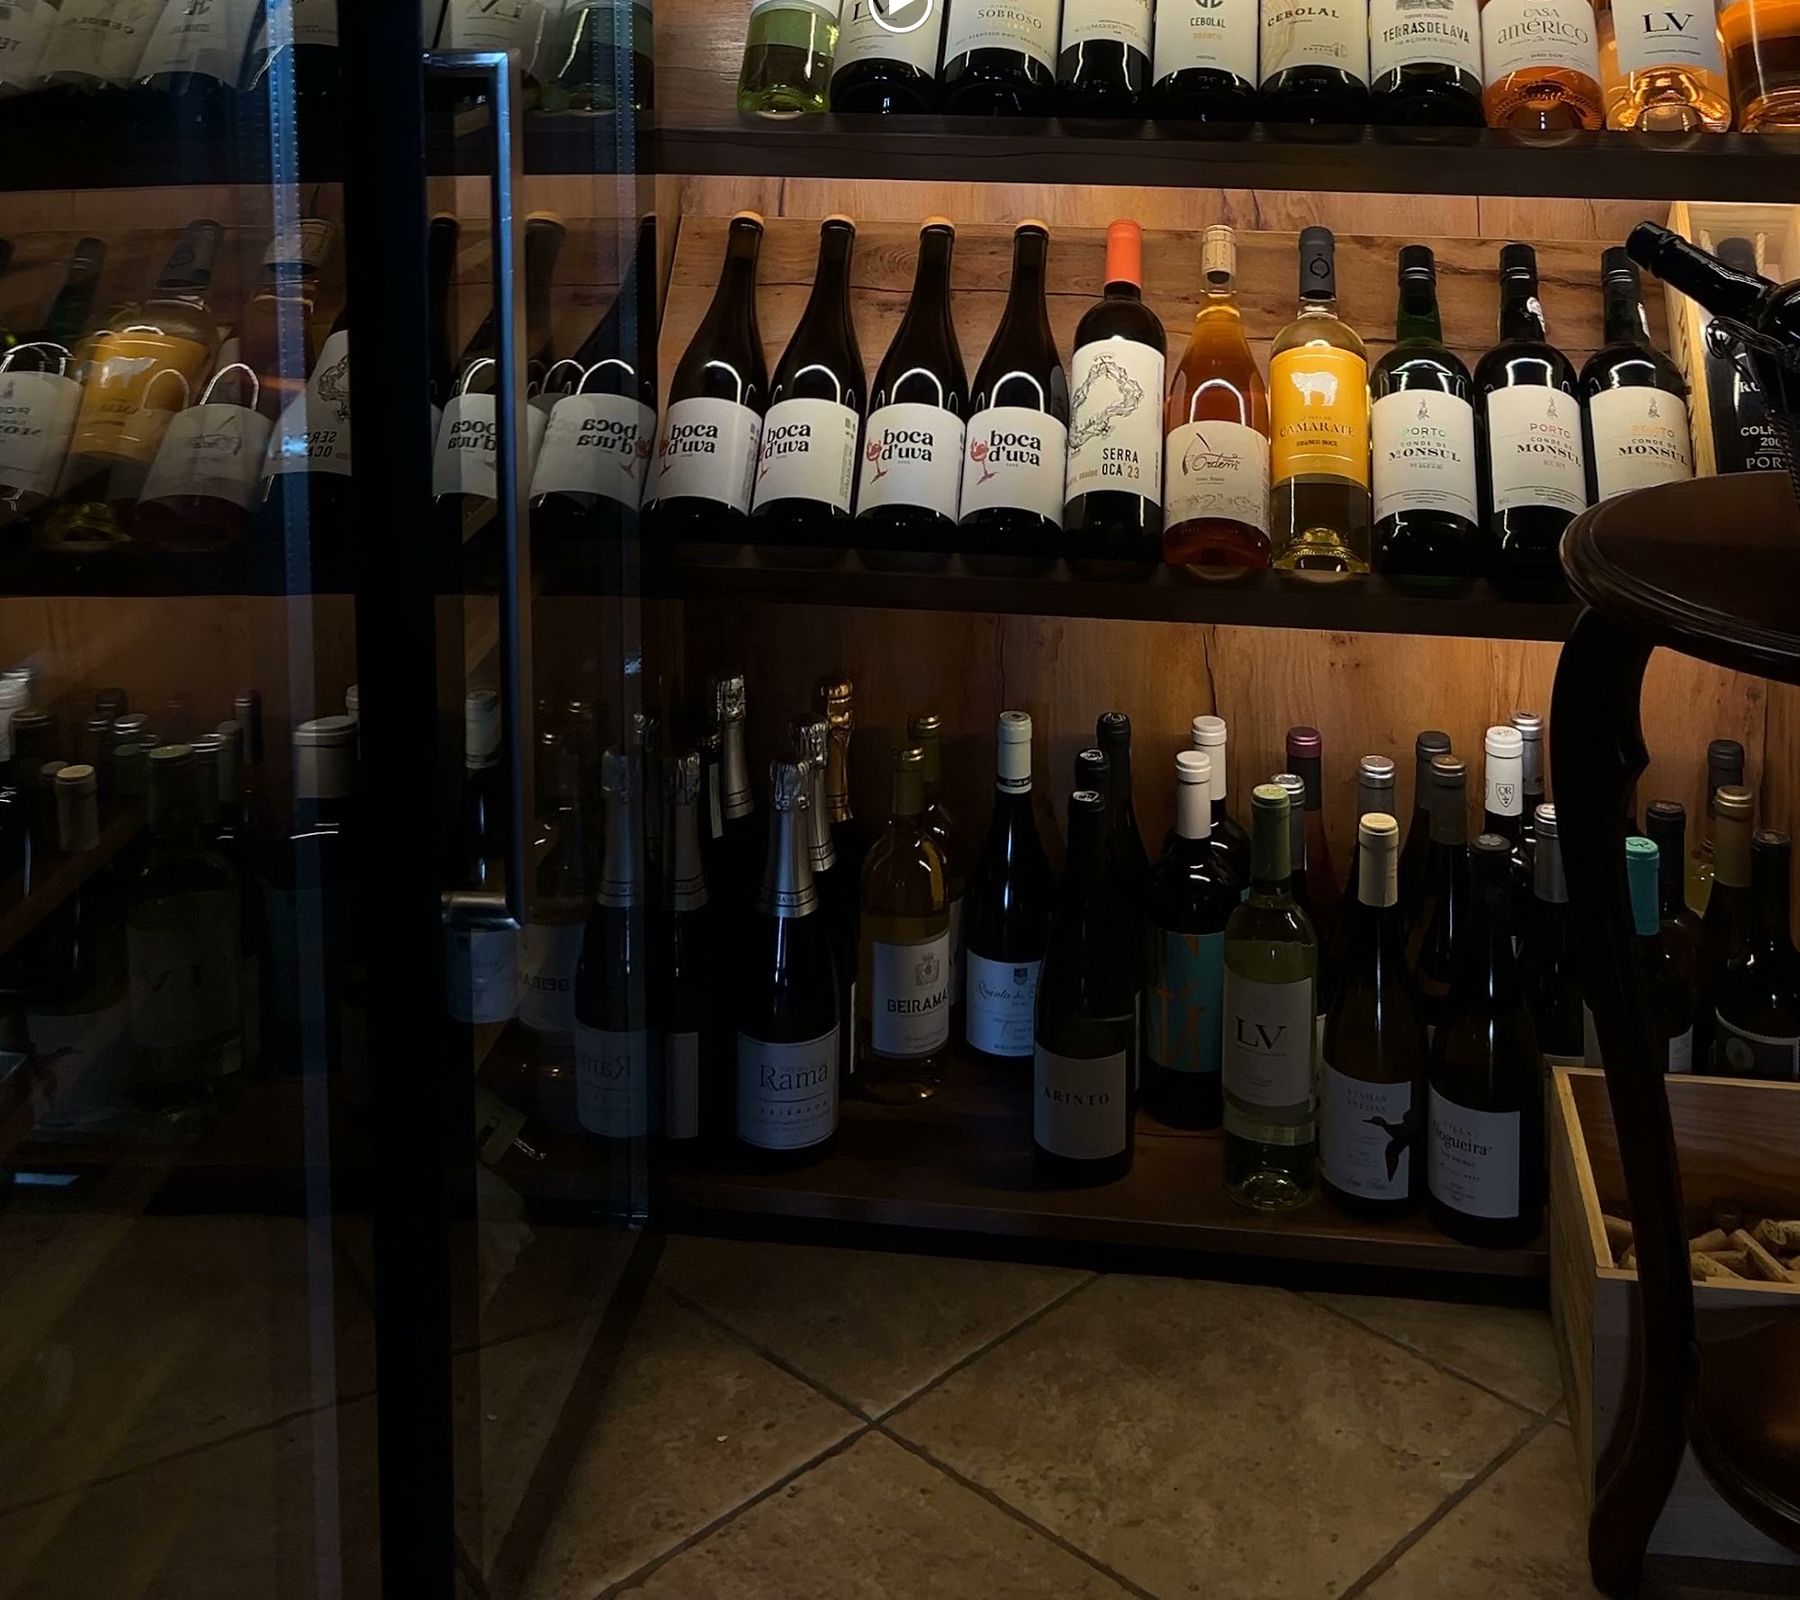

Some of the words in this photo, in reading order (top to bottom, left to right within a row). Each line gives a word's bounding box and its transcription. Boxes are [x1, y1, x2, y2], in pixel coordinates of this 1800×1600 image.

[977, 9, 1042, 30] SOBROSO
[1267, 7, 1340, 27] CEBOLAL
[1523, 7, 1561, 18] CASA
[1190, 16, 1227, 29] CEBOLAL
[1641, 11, 1694, 34] LV
[671, 423, 719, 441] boca
[766, 423, 811, 444] boca
[882, 428, 934, 447] boca
[1279, 421, 1354, 438] CAMARATE
[1529, 422, 1571, 439] PORTO
[667, 438, 716, 456] d'uva
[764, 439, 809, 460] d'uva
[990, 429, 1041, 451] boca
[1531, 436, 1561, 445] CONDE
[1632, 438, 1664, 446] CONDE
[881, 443, 933, 462] d'uva
[988, 445, 1040, 467] d'uva
[1102, 447, 1139, 464] SERRA
[1388, 446, 1462, 463] MONSUL
[1517, 443, 1582, 468] MONSUL
[1618, 445, 1688, 466] MONSUL
[1101, 462, 1123, 476] OCA
[1235, 1015, 1288, 1050] LV
[760, 1063, 828, 1092] Rama
[1042, 1086, 1110, 1105] ARINTO
